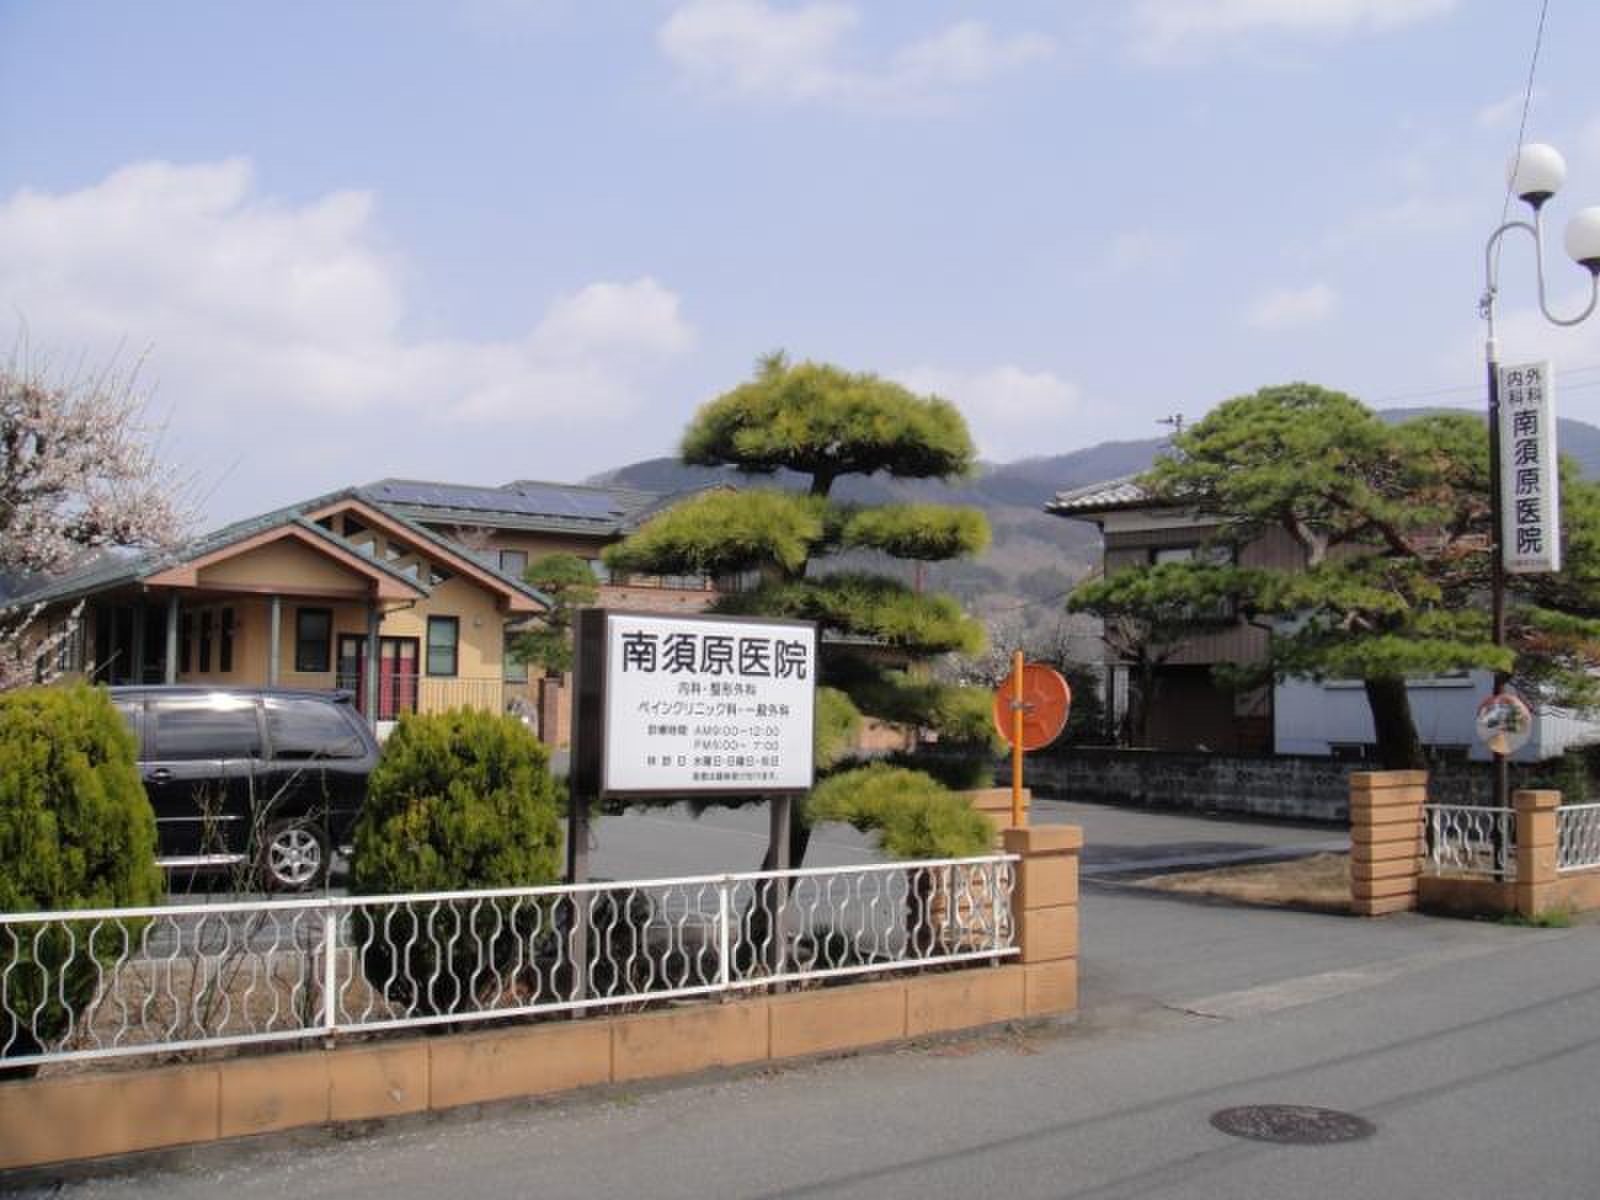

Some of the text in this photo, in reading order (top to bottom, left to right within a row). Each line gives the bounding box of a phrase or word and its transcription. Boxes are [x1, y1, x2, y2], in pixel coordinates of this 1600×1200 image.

[1507, 370, 1523, 405] 内科
[1525, 367, 1542, 404] 外科
[1514, 409, 1543, 554] 南須原医院
[621, 630, 807, 680] 南須原医院
